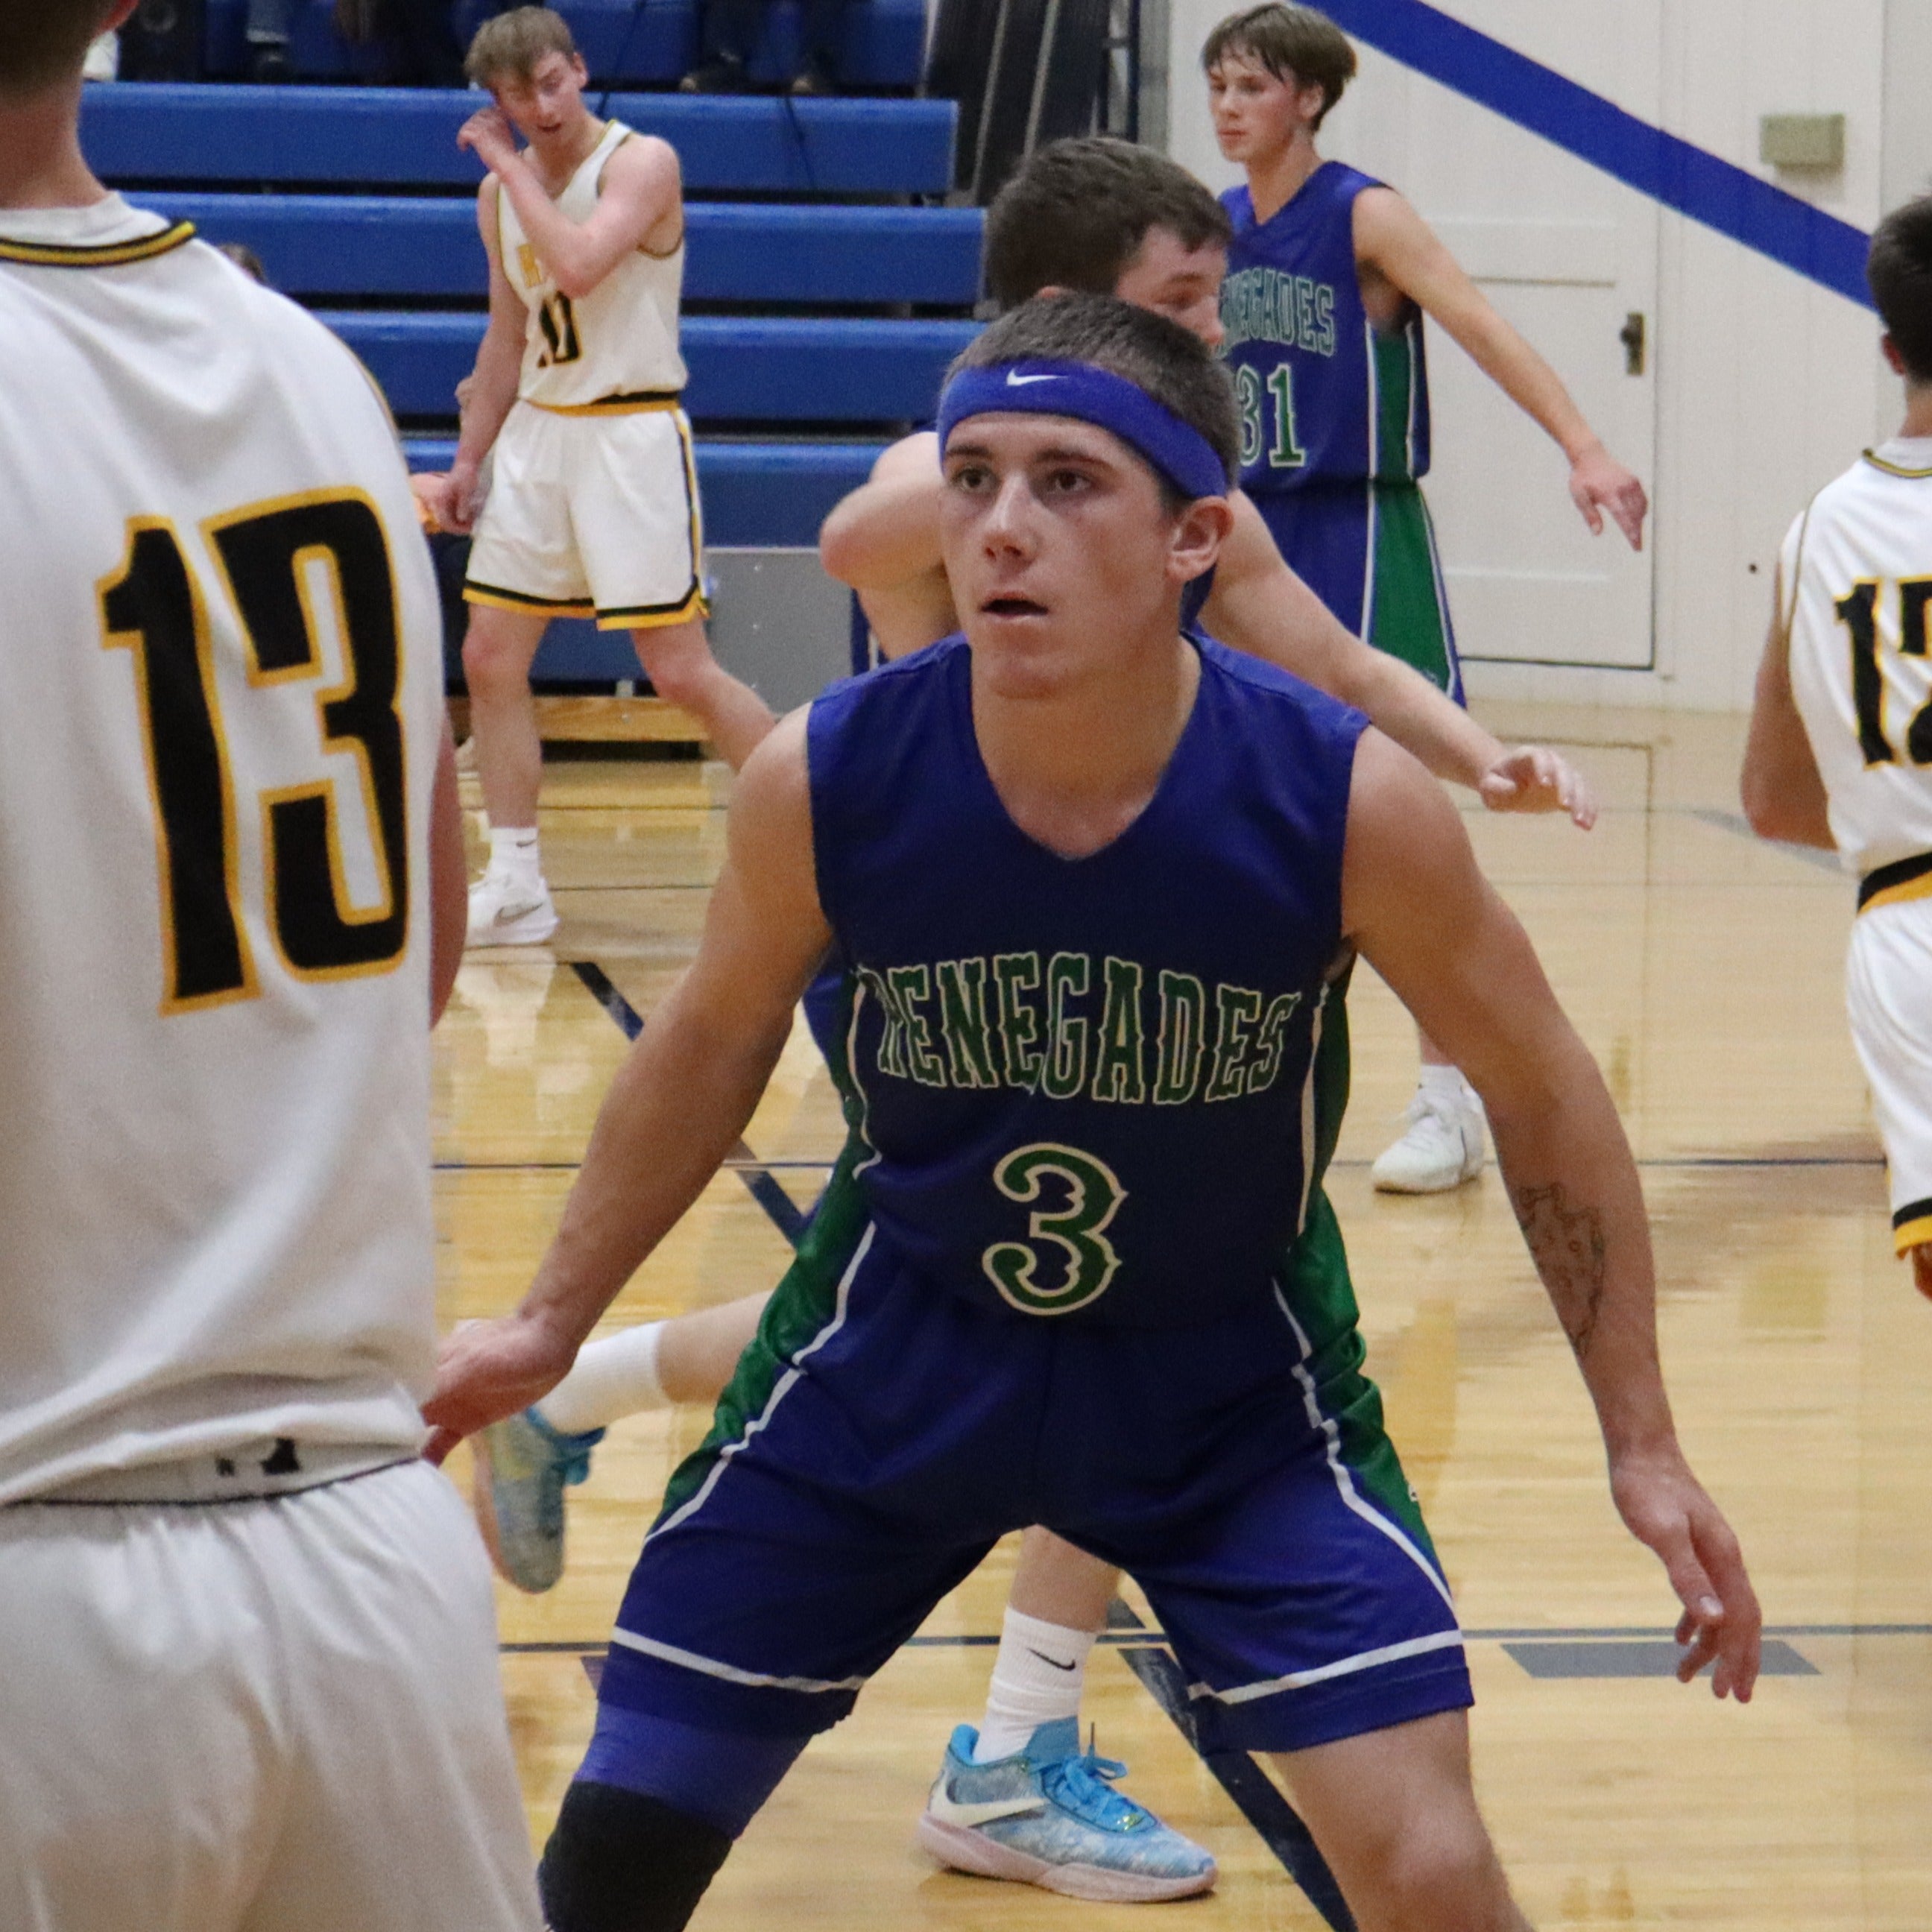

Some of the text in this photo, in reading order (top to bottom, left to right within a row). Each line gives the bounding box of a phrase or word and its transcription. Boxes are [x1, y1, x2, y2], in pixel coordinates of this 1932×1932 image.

[1235, 362, 1306, 467] 31
[92, 484, 411, 1017] 13
[982, 1142, 1128, 1316] 3
